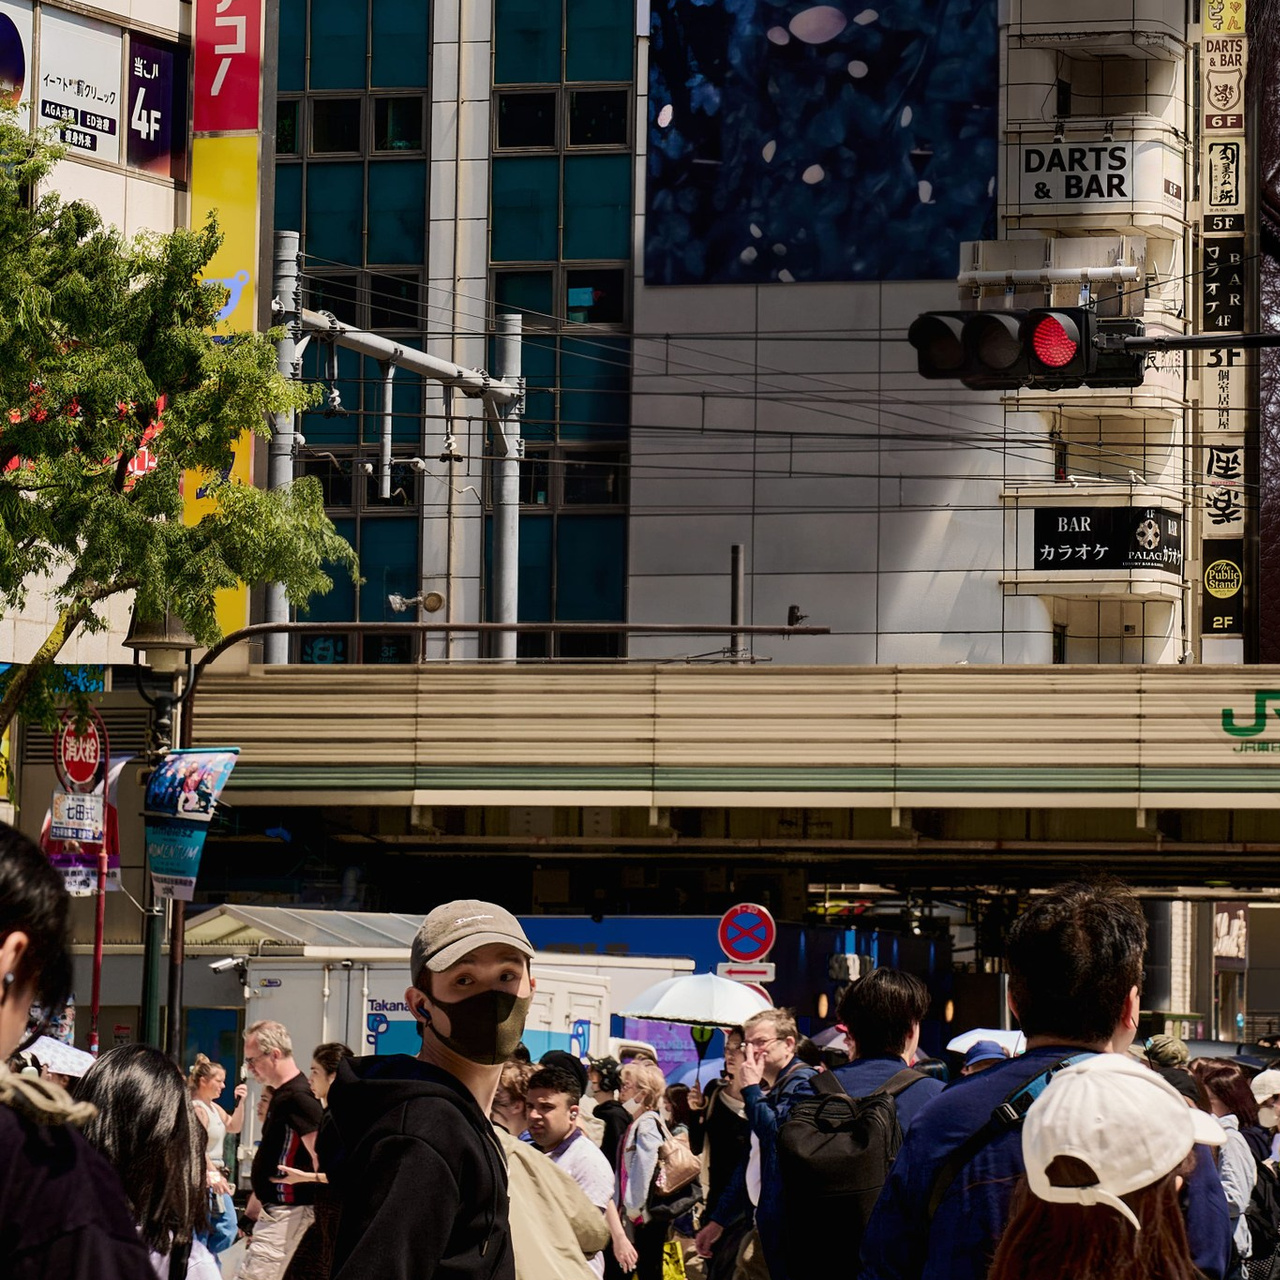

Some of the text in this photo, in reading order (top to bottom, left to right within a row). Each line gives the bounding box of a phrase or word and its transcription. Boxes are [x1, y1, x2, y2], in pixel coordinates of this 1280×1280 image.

[1206, 39, 1243, 53] DARTS
[1209, 53, 1243, 67] & BAR
[131, 87, 162, 141] 4F
[1211, 116, 1237, 128] 6F
[1025, 146, 1127, 173] DARTS
[1034, 173, 1128, 199] & BAR
[1213, 217, 1235, 230] 5F
[1215, 315, 1232, 327] 4F
[1207, 348, 1241, 368] 3F
[1057, 516, 1092, 533] BAR
[1167, 519, 1178, 537] BAR
[1039, 543, 1110, 562] カラオケ
[1208, 569, 1240, 580] Public
[1208, 579, 1238, 589] Stand
[1212, 616, 1233, 629] 2F
[65, 735, 97, 764] 消火栓
